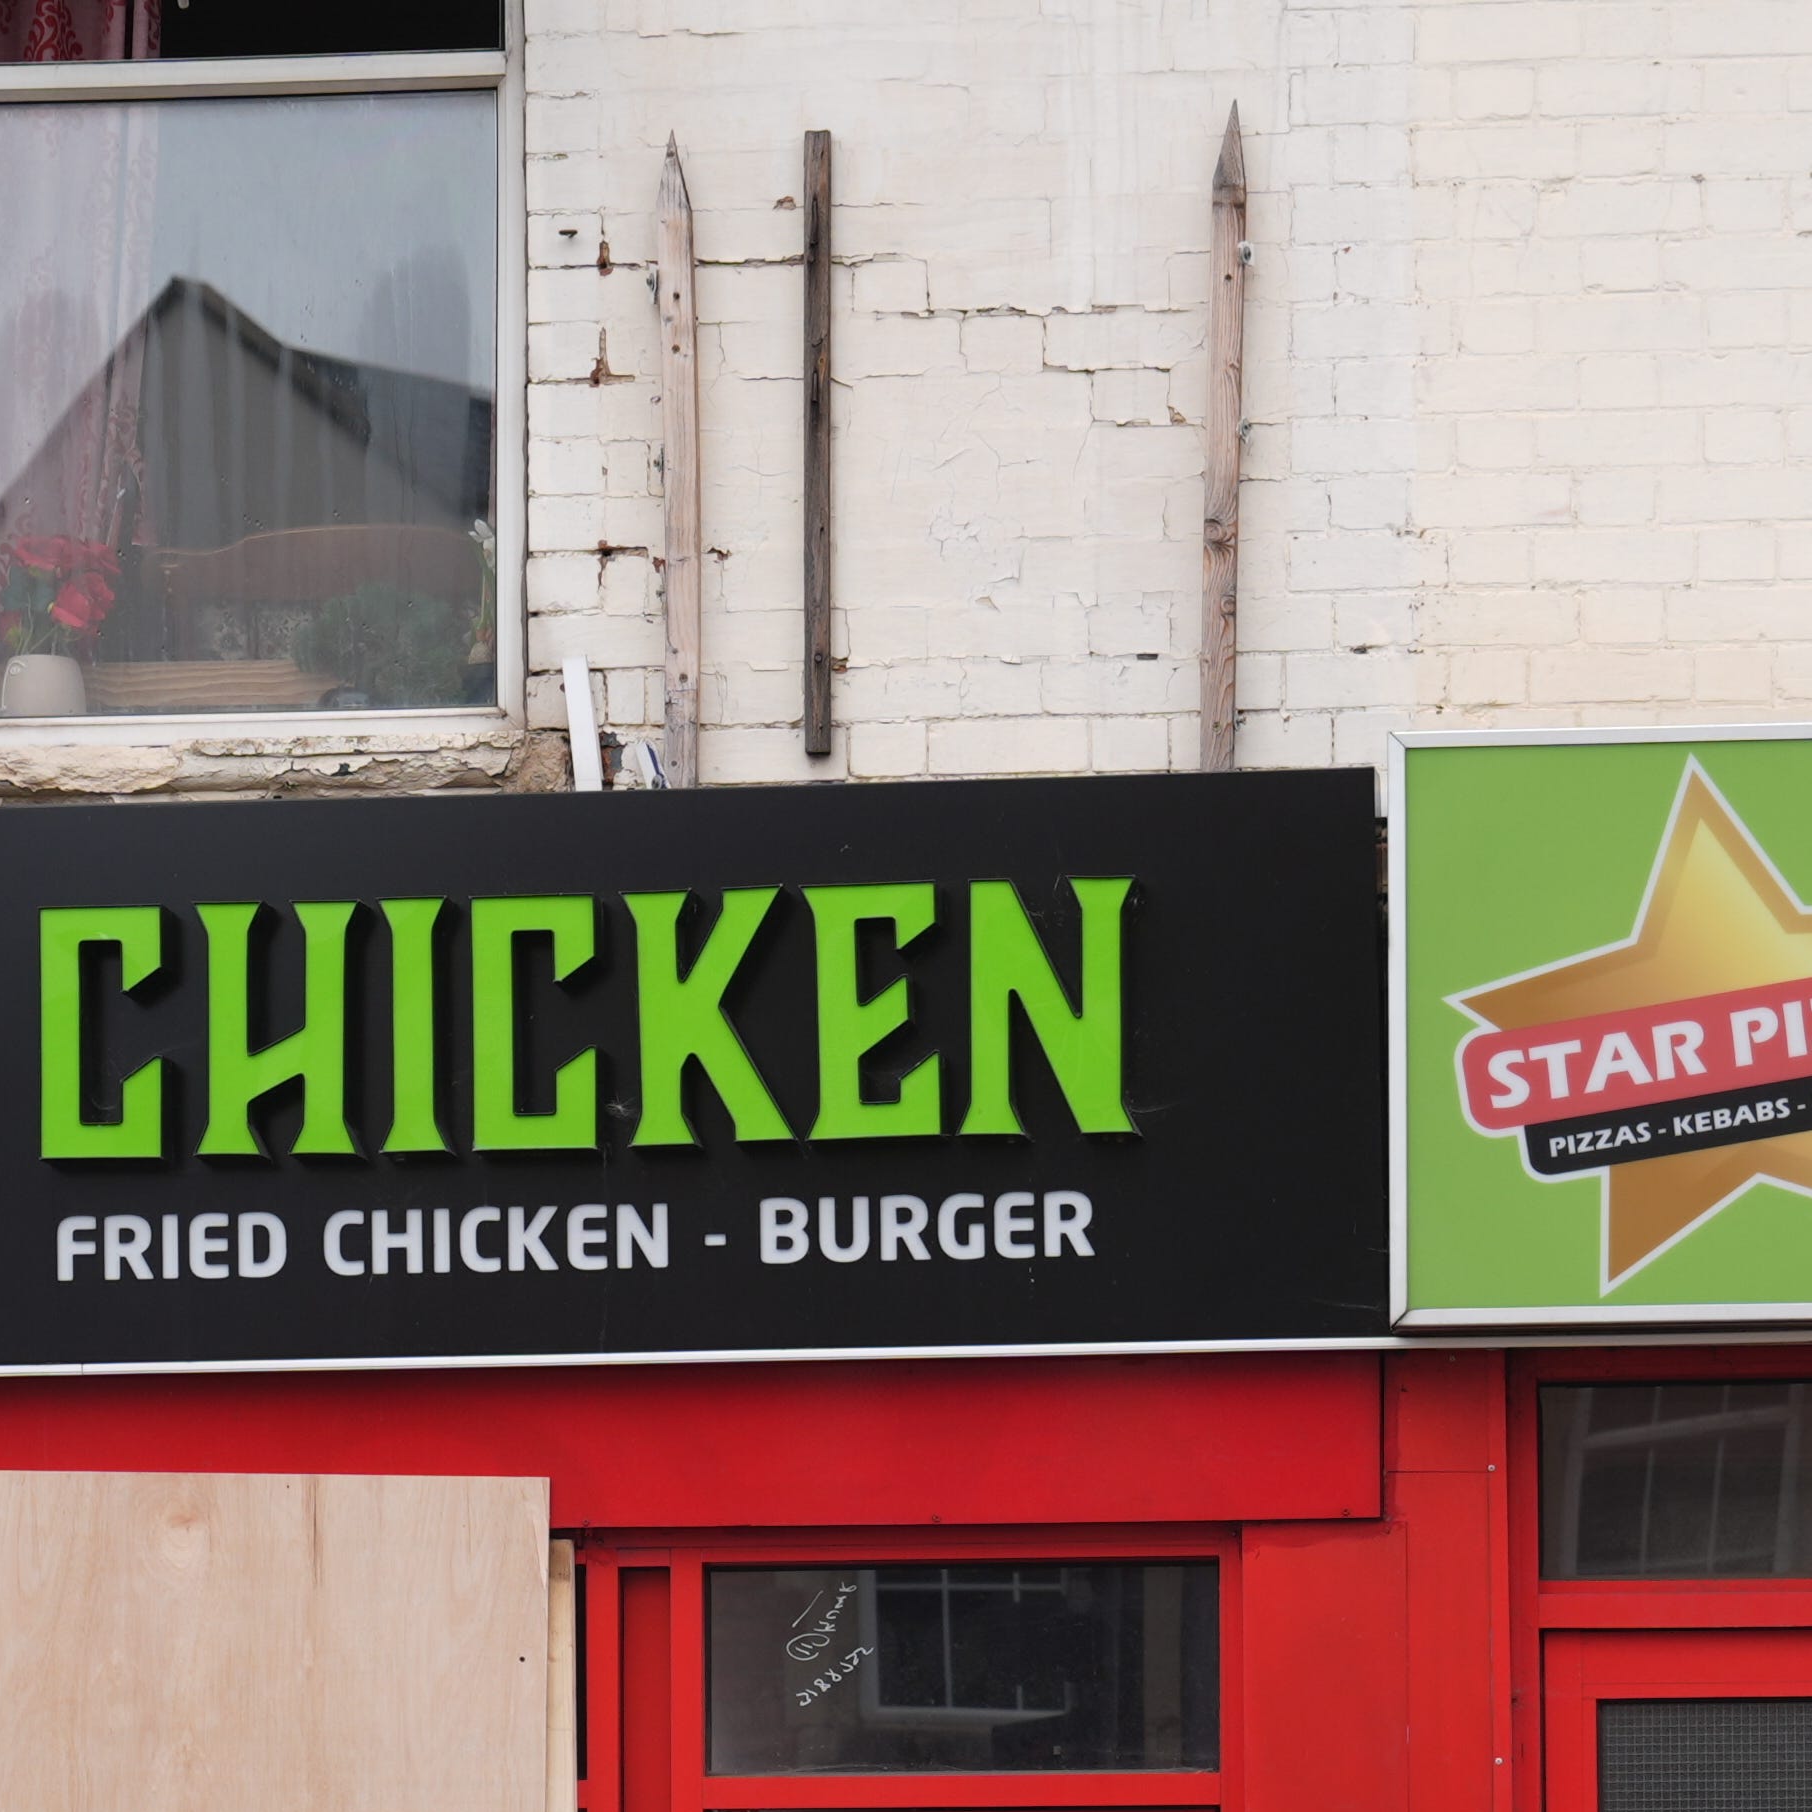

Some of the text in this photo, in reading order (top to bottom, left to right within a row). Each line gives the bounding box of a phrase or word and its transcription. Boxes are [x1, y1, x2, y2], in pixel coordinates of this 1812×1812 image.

[40, 878, 1132, 1159] CHICKEN
[1488, 1021, 1706, 1109] STAR
[1549, 1122, 1651, 1157] PIZZAS
[1673, 1098, 1790, 1136] KEBABS
[56, 1212, 287, 1282] FRIED
[323, 1204, 669, 1277] CHICKEN
[760, 1191, 1096, 1264] BURGER
